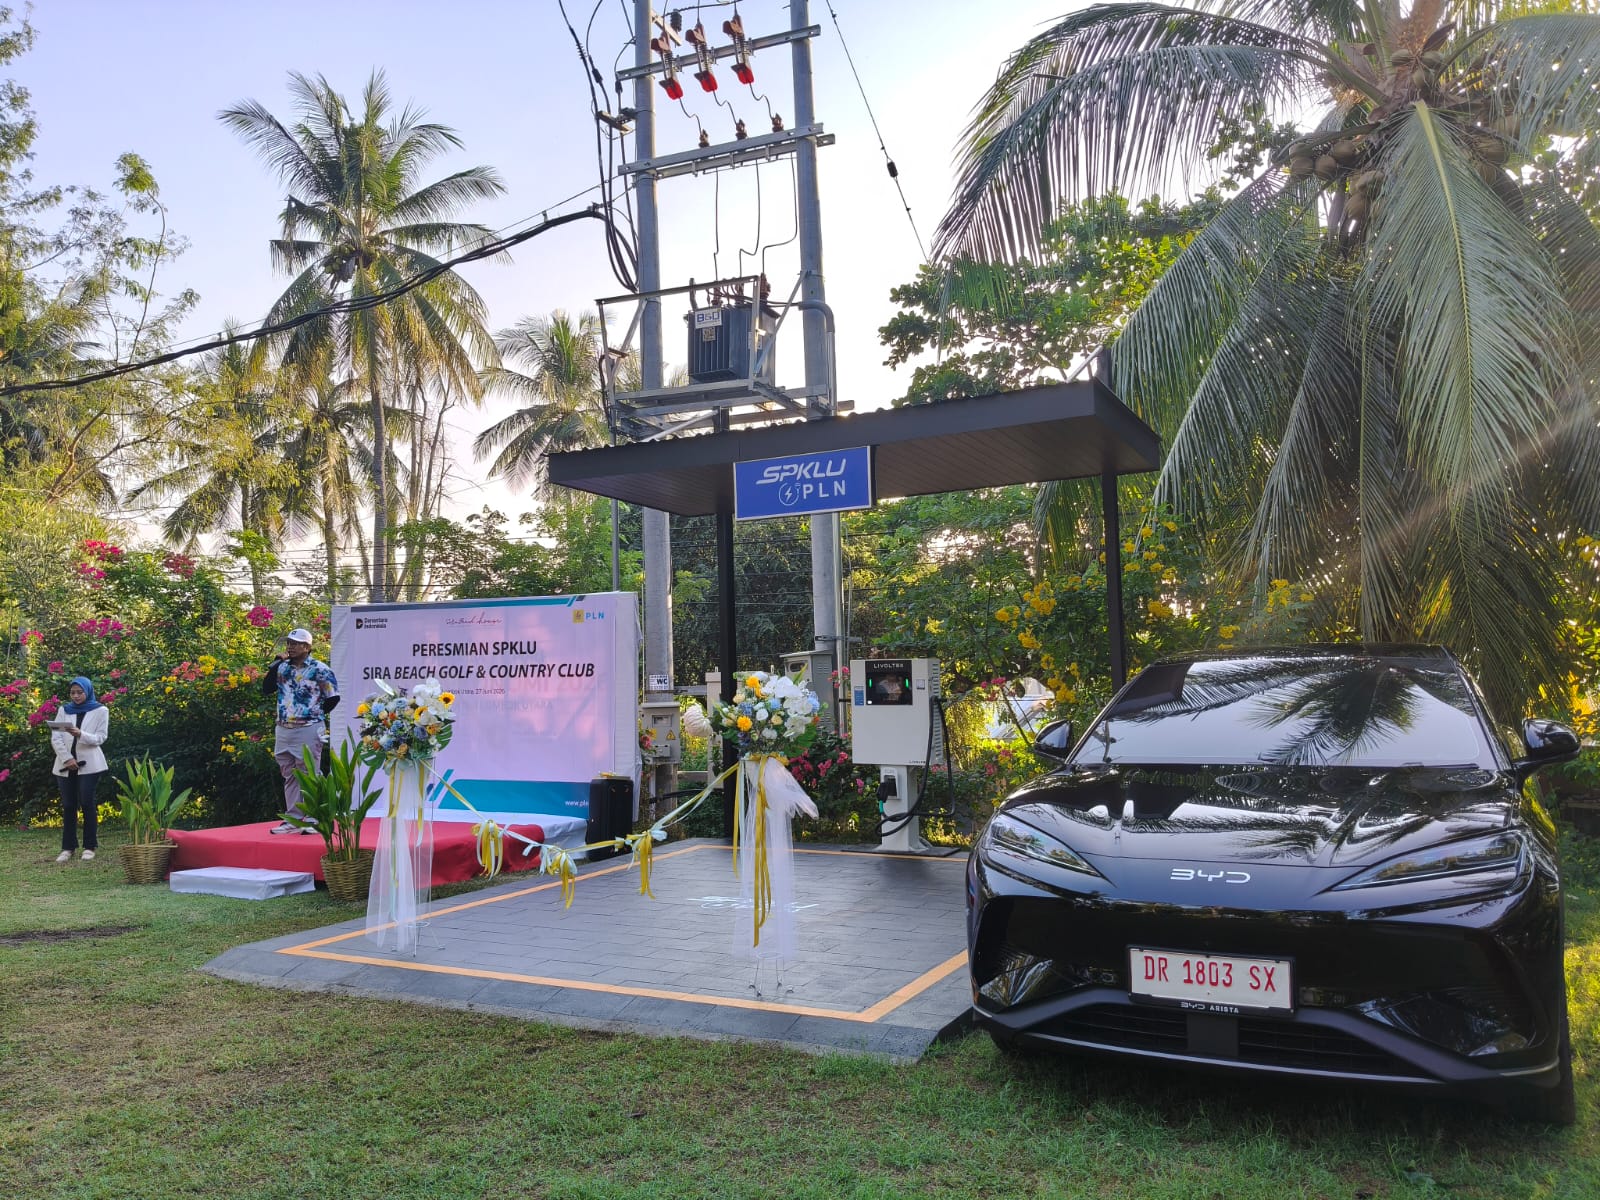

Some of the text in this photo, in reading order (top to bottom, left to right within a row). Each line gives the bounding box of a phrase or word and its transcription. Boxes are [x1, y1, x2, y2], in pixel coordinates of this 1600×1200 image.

[756, 458, 847, 485] SPKLU
[803, 480, 846, 499] PLN
[586, 611, 605, 620] PLN
[412, 640, 537, 657] PERESMIAN SPKLU
[363, 663, 595, 680] SIRA BEACH GOLF & COUNTRY CLUB
[1170, 868, 1251, 884] BYD
[1143, 955, 1276, 993] DR 1803 SX
[1180, 1001, 1206, 1010] BYD
